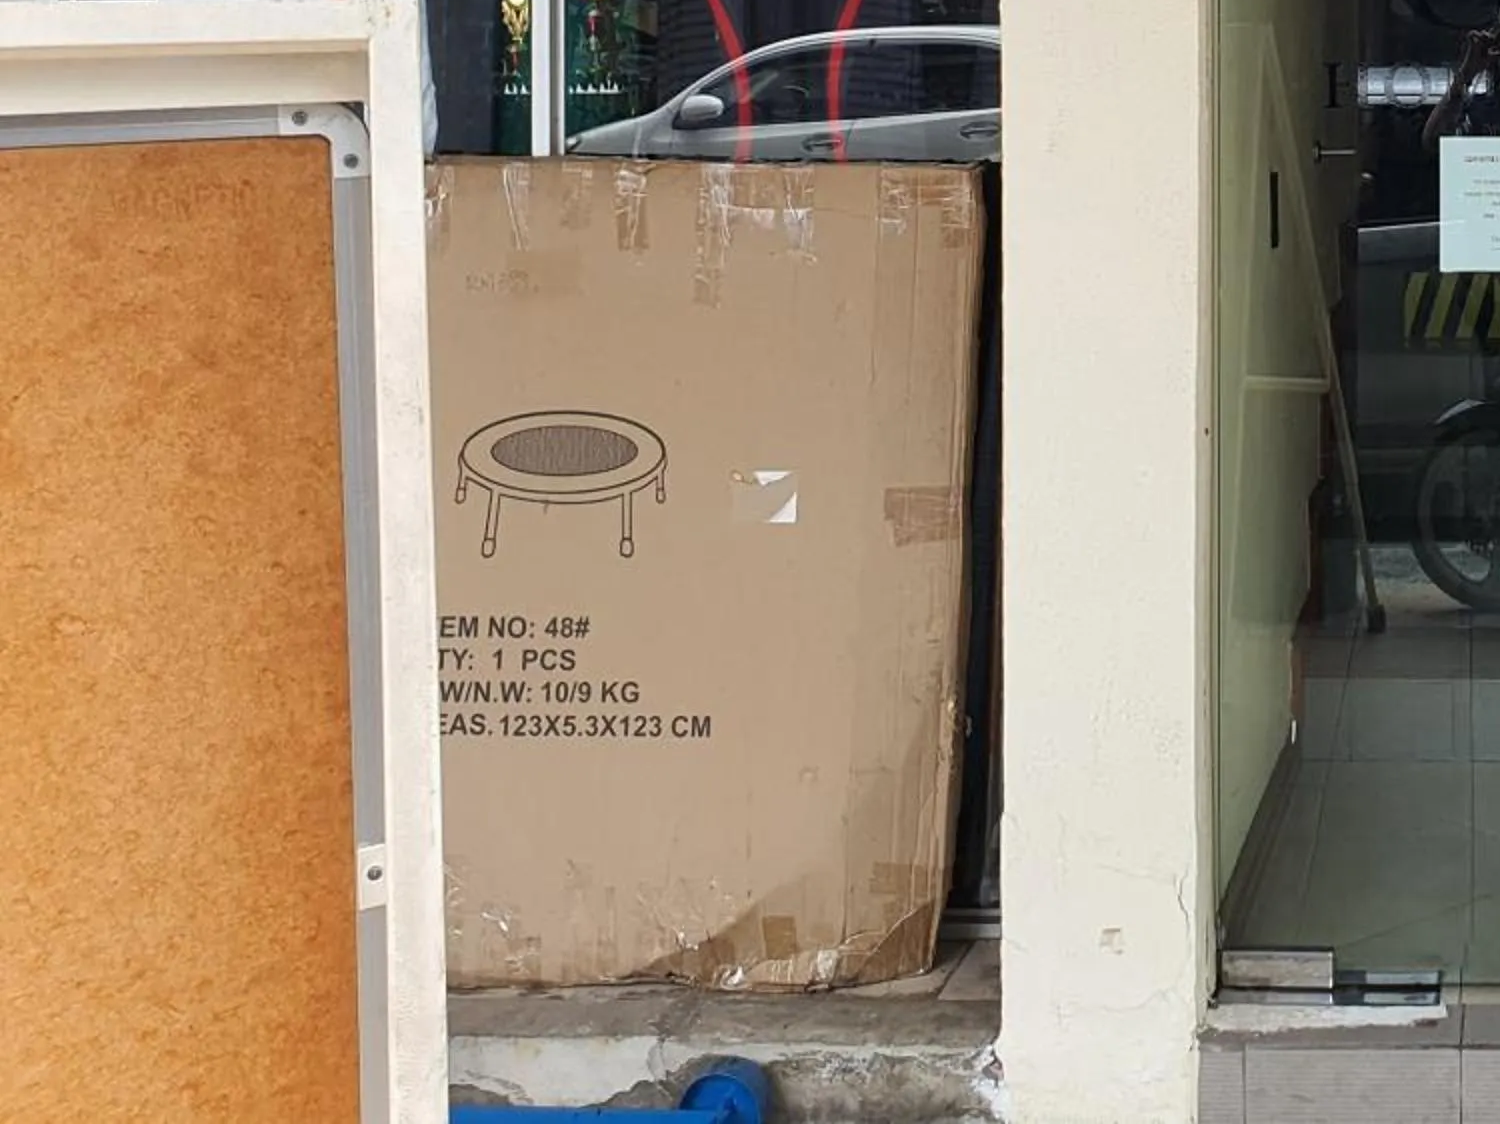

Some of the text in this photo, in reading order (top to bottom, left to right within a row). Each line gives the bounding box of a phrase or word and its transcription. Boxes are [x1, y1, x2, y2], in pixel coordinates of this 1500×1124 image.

[439, 616, 590, 638] EM NO: 48#
[438, 649, 576, 671] TY: 1 PCS
[440, 681, 640, 703] W/N.W: 10/9 KG
[439, 713, 712, 738] EAS. 123X5.3X123 CM
